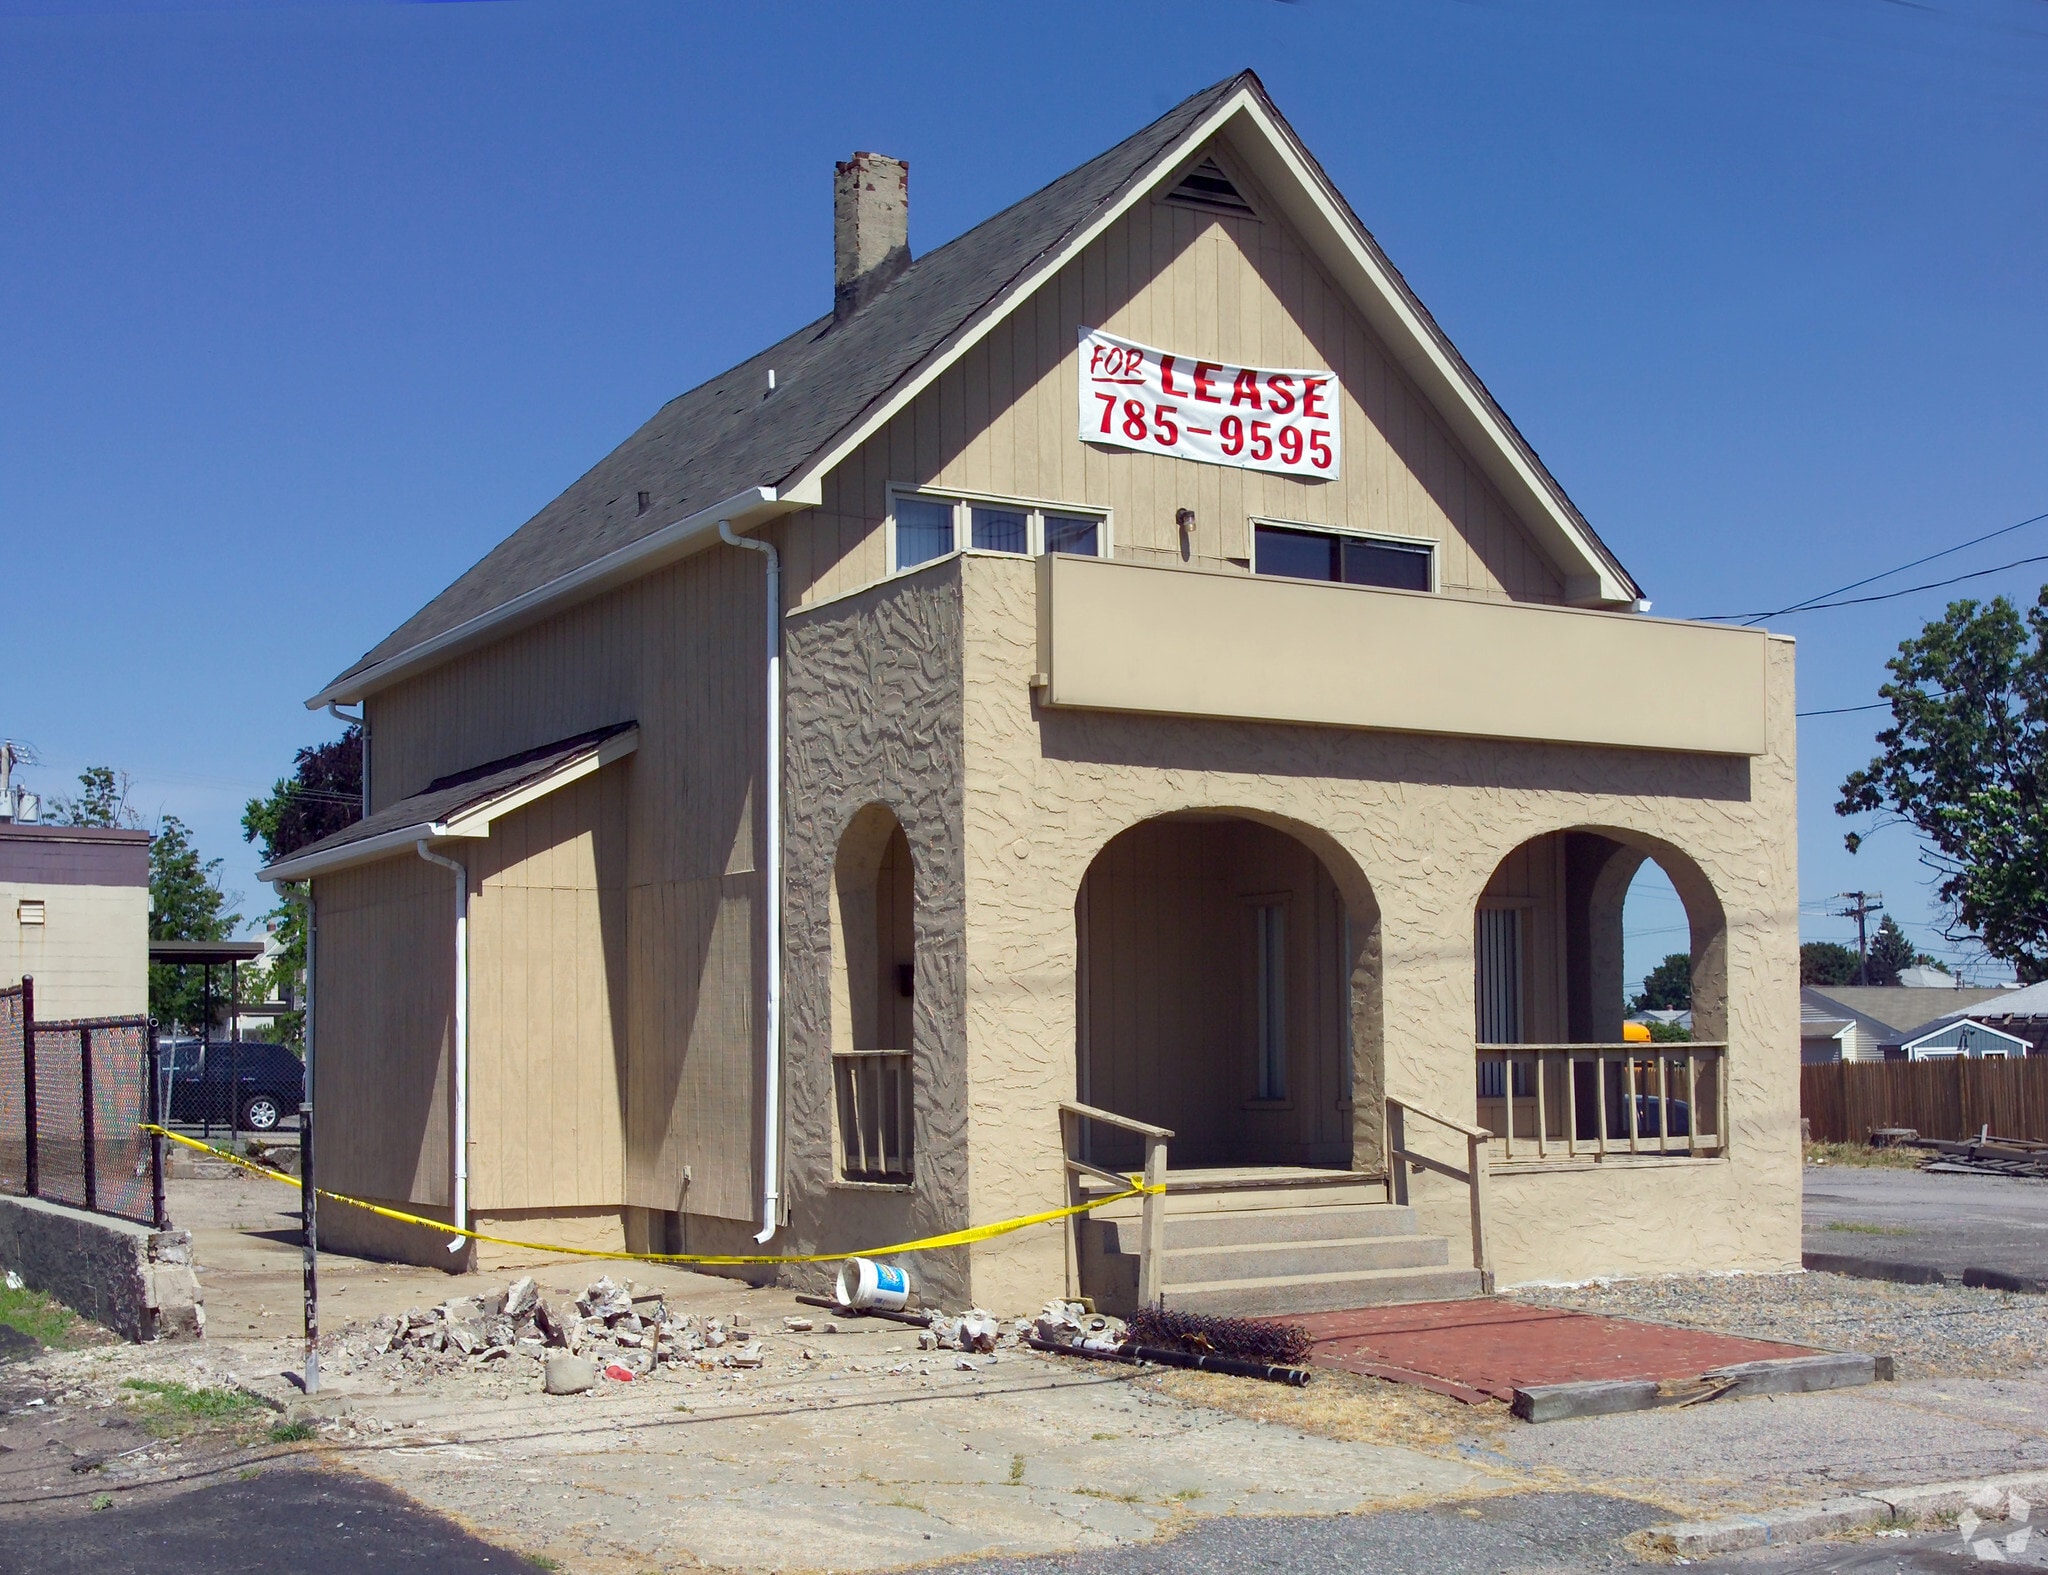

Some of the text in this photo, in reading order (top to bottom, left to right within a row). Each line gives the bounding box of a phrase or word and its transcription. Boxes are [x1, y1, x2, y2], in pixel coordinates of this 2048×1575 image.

[1090, 345, 1329, 420] FOR LEASE
[1094, 392, 1333, 469] 785-9595
